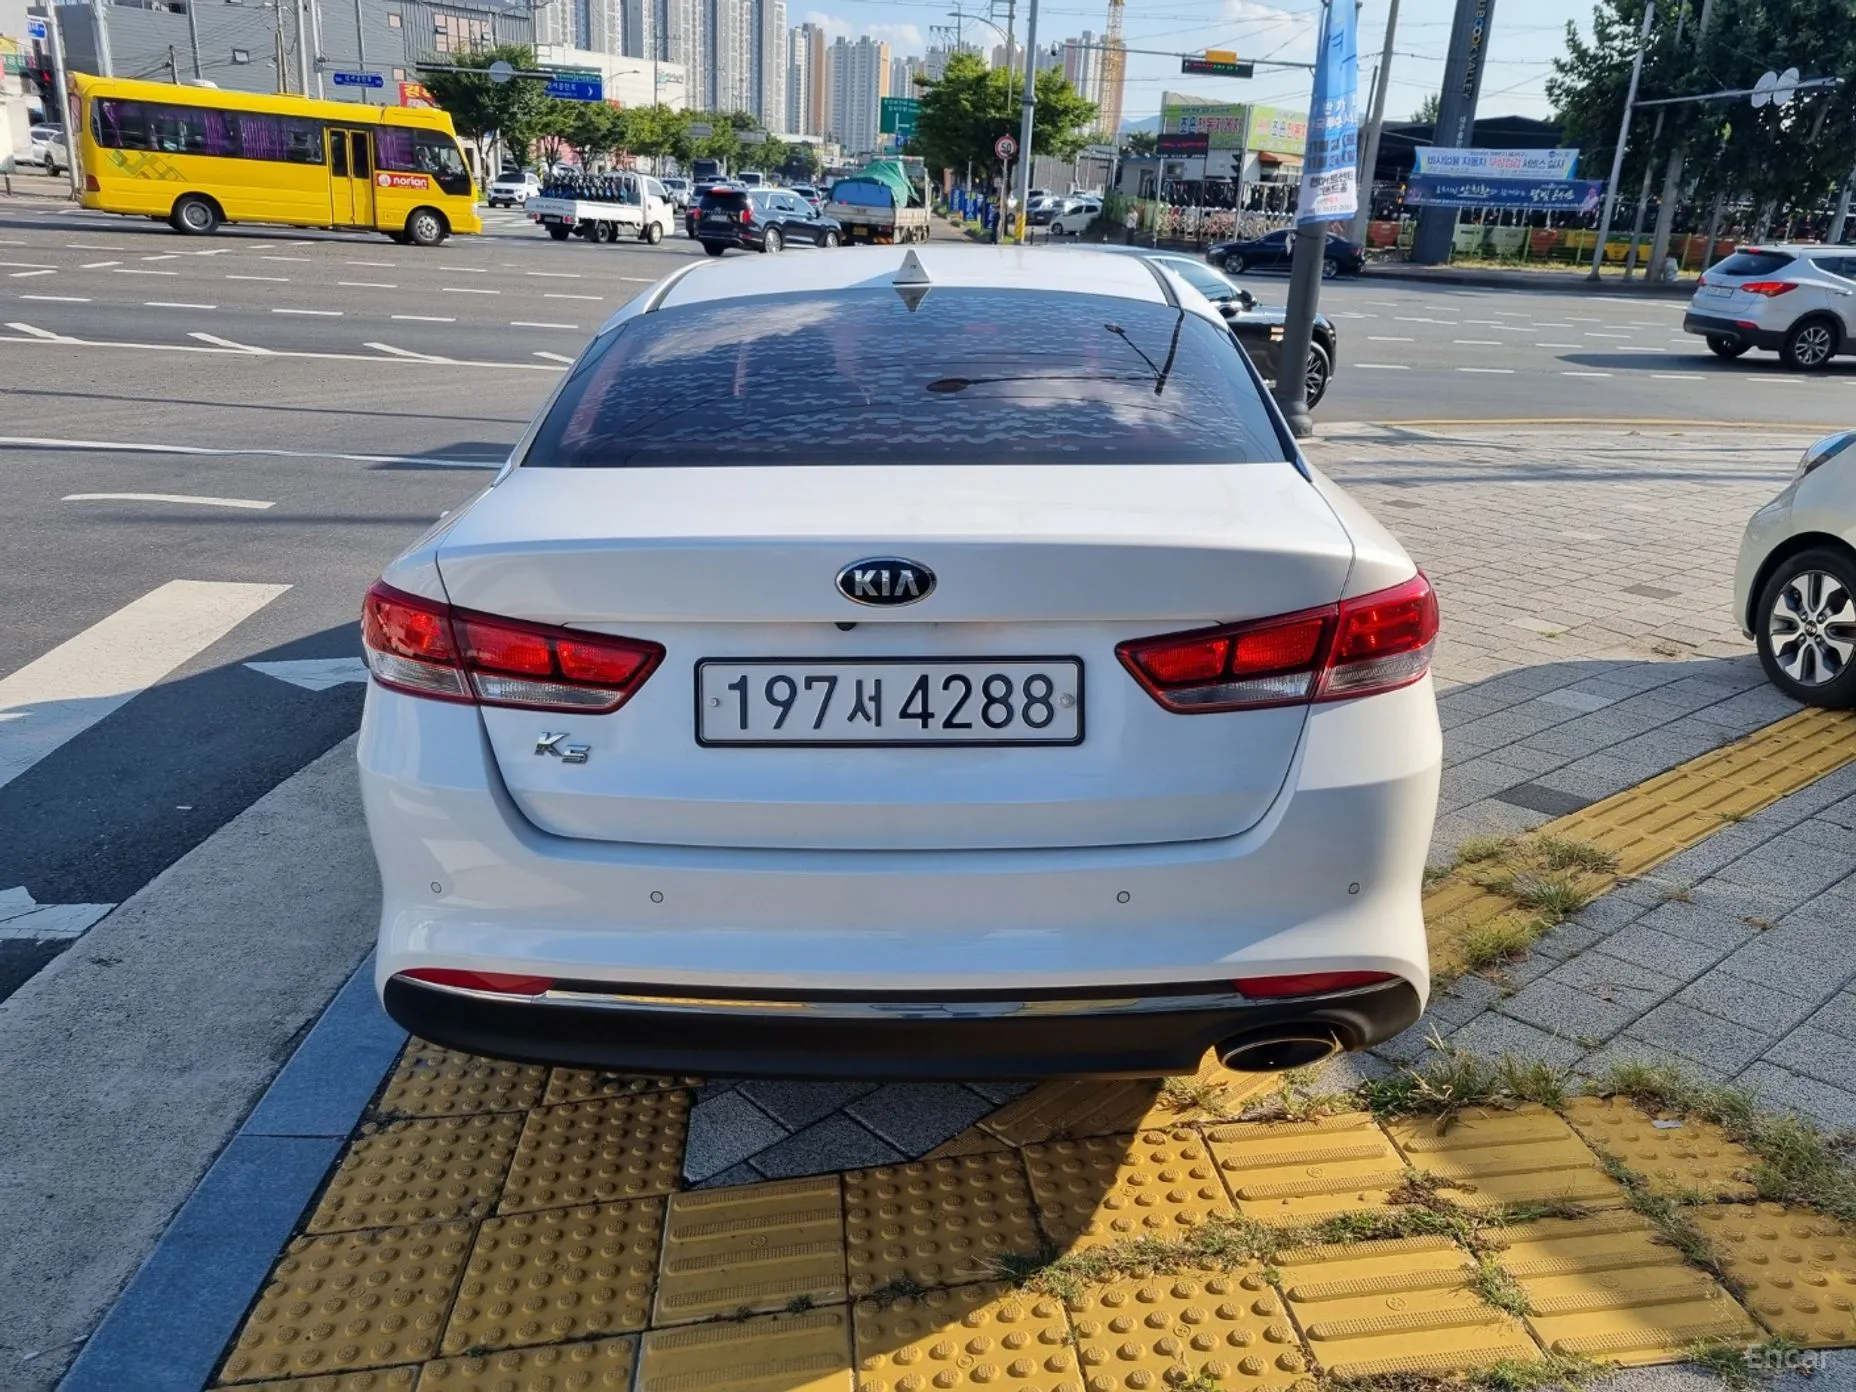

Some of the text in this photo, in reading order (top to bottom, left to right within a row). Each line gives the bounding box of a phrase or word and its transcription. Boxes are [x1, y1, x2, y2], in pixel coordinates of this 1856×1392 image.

[1000, 142, 1012, 154] 50
[1462, 156, 1487, 166] 자동차
[393, 176, 427, 187] norian
[853, 569, 920, 596] KIA
[535, 731, 592, 764] K5
